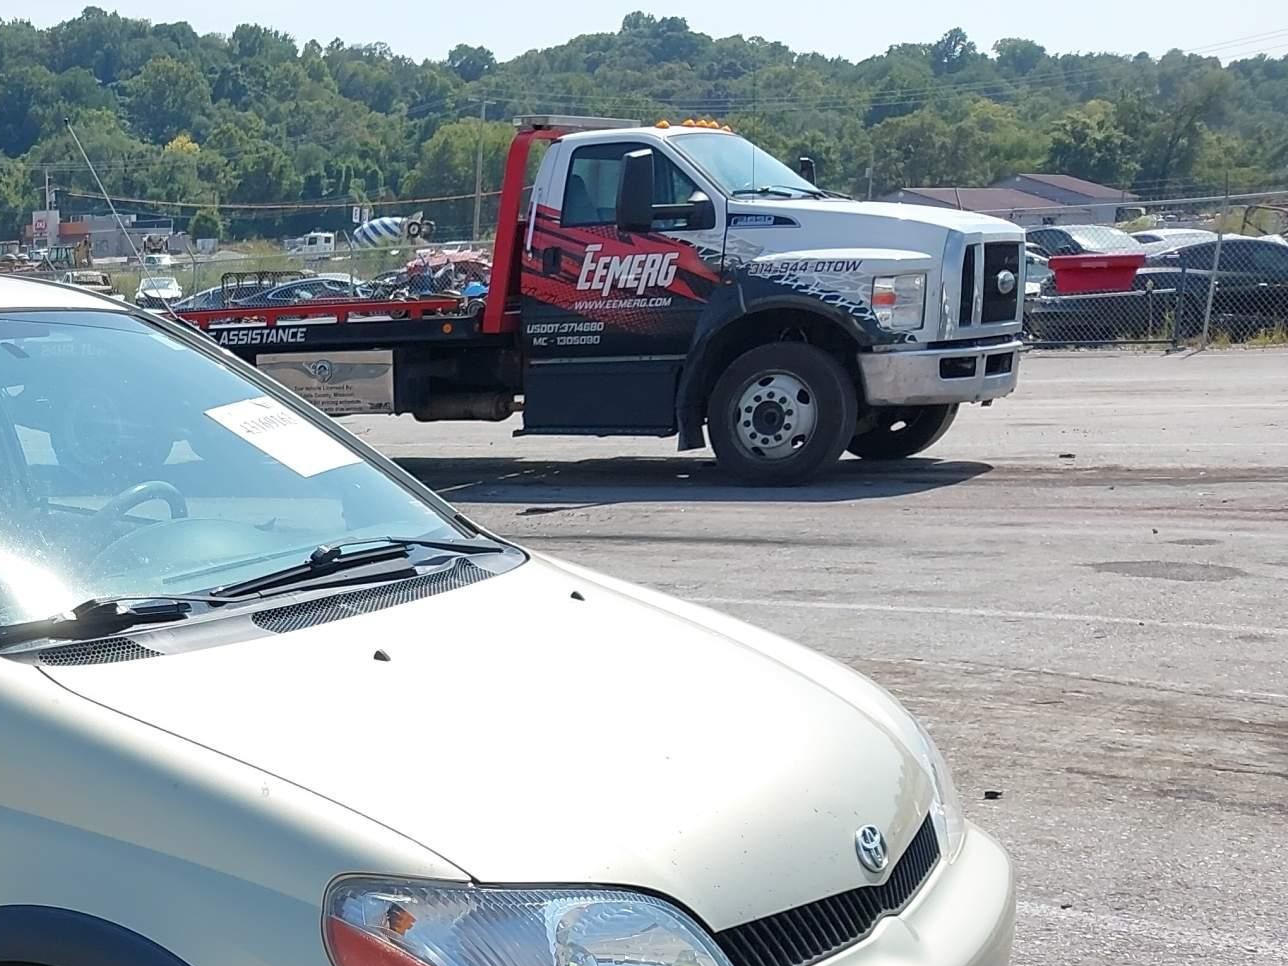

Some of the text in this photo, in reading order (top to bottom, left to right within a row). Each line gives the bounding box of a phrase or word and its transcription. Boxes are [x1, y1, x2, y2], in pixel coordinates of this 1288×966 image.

[576, 243, 680, 297] EEMERG
[574, 297, 672, 311] WWW.EEMERG.COM
[219, 328, 308, 346] ASSISTANCE
[532, 336, 548, 347] MC
